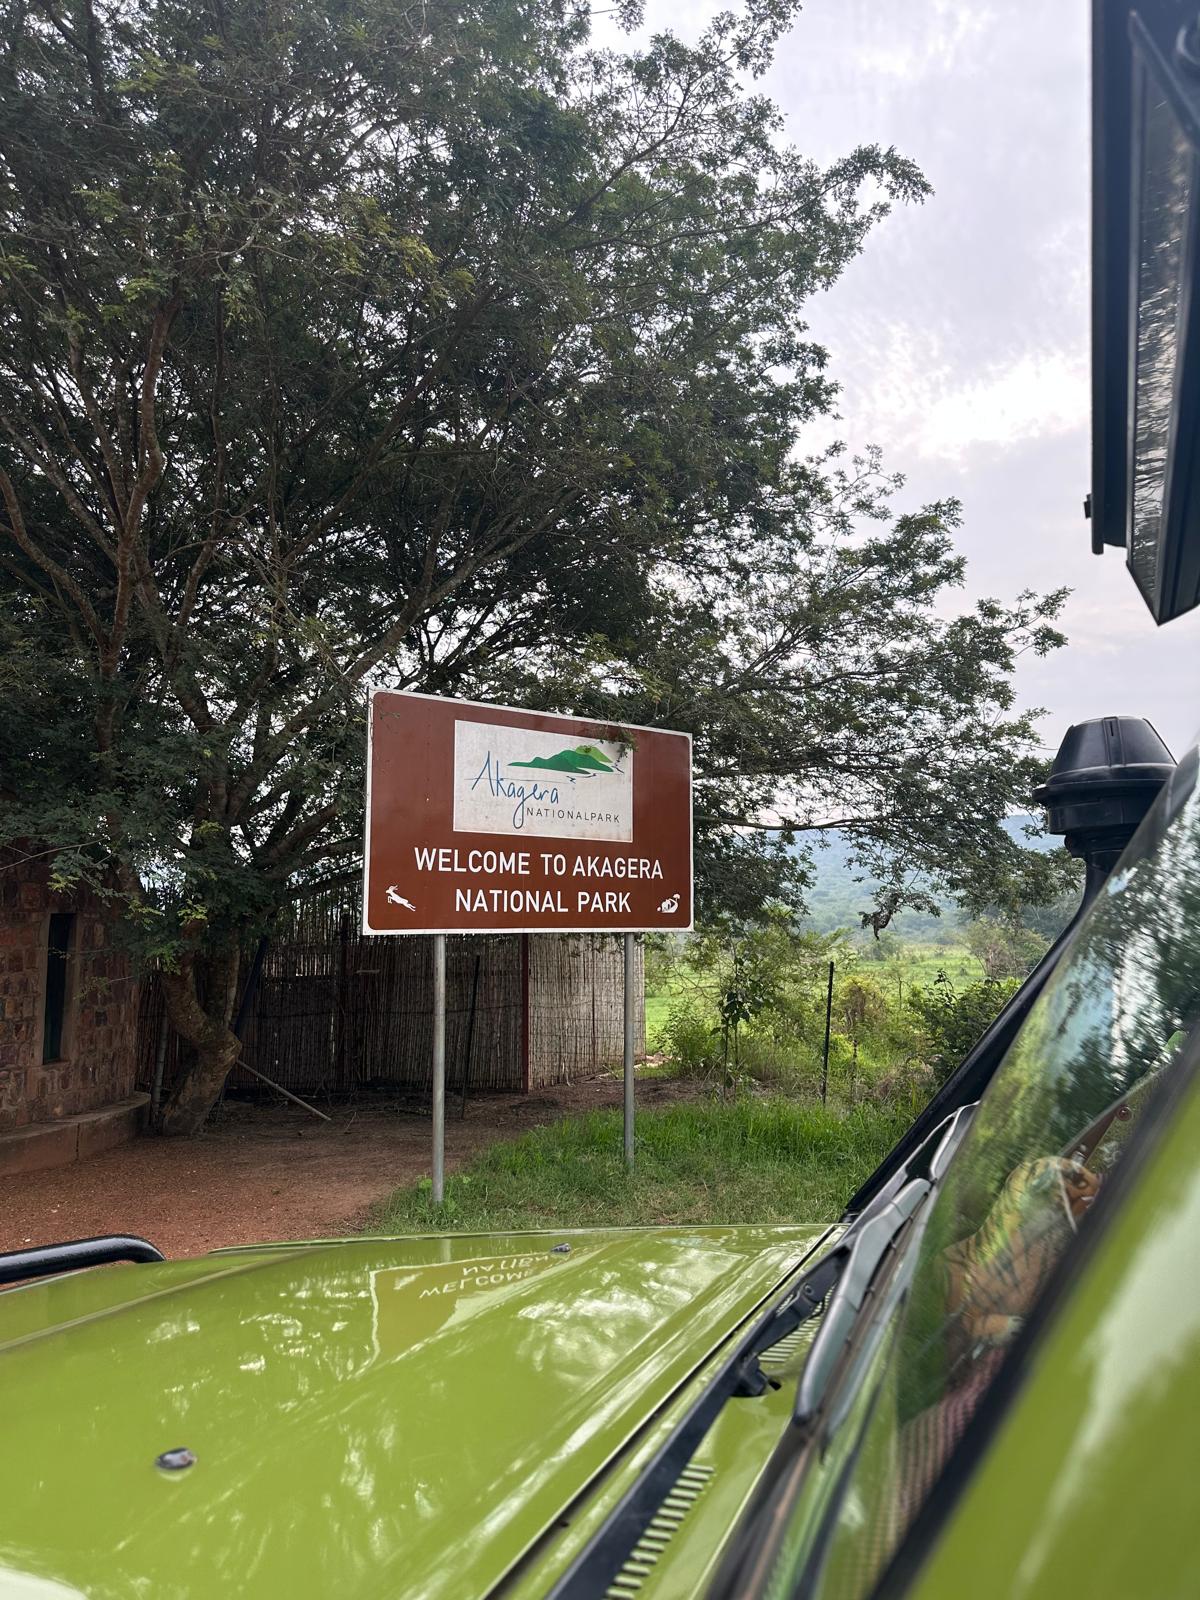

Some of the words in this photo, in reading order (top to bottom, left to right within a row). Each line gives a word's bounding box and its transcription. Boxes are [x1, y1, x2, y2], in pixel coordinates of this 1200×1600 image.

[471, 750, 559, 829] Akagera
[414, 847, 530, 875] WELCOME
[541, 853, 567, 876] TO
[572, 856, 664, 880] AKAGERA
[455, 889, 569, 913] NATIONAL
[577, 892, 632, 913] PARK
